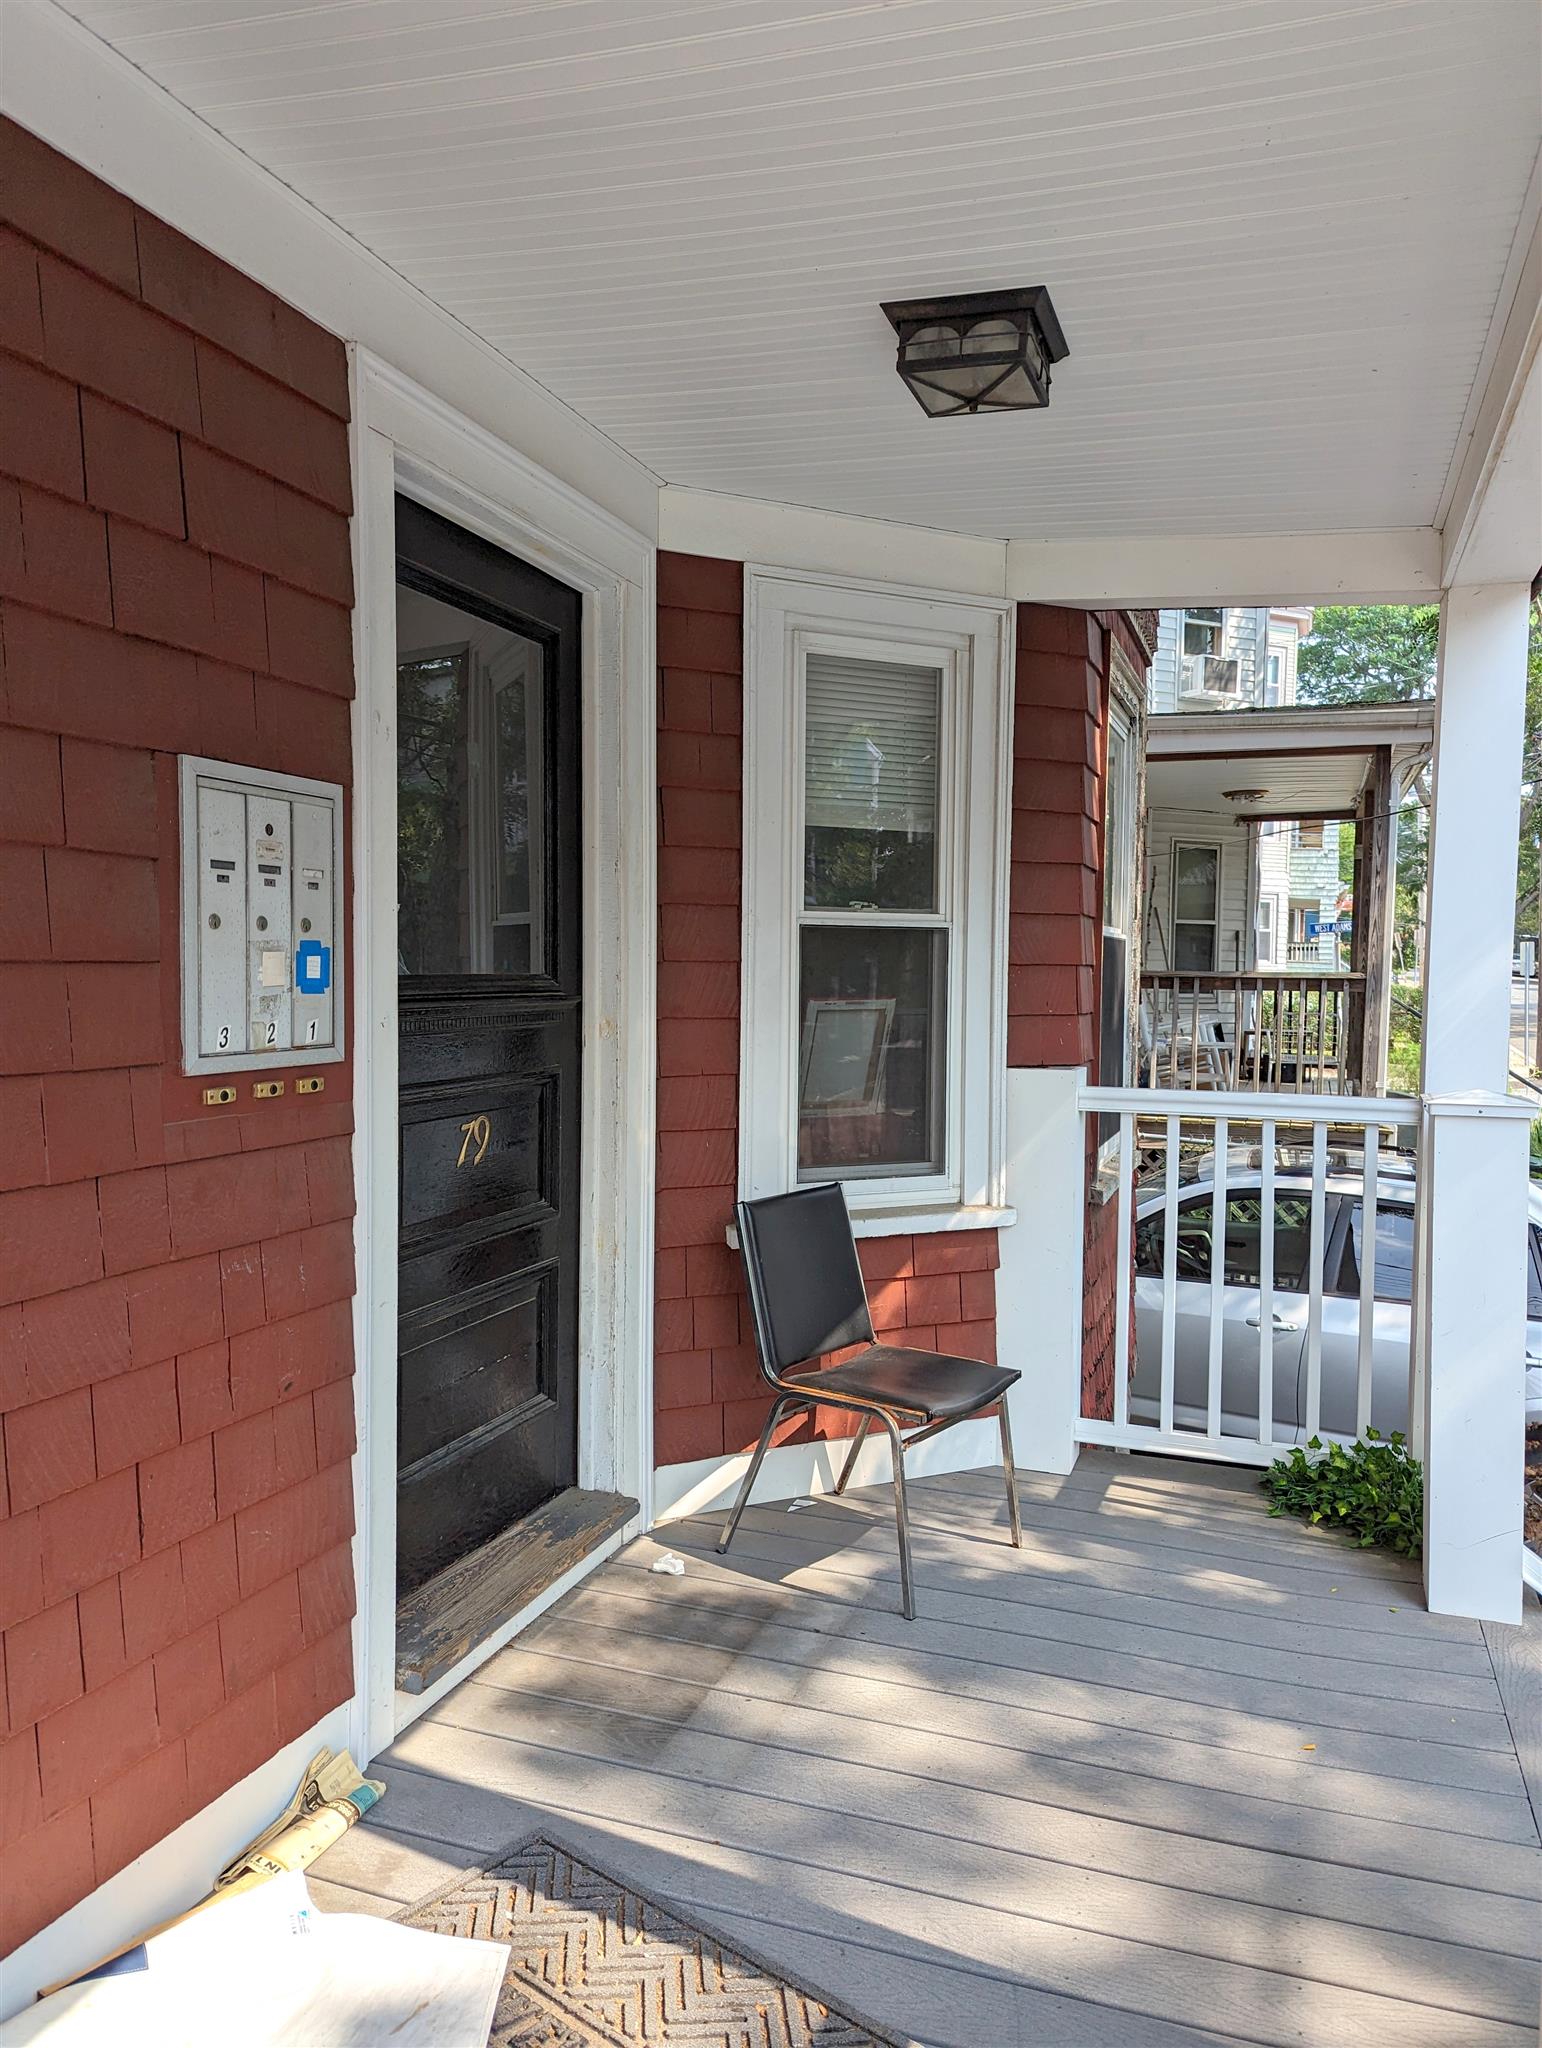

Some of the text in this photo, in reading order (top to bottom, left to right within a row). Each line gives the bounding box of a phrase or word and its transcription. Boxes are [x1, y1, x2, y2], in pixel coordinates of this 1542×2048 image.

[1314, 922, 1352, 933] WEST ADAMS
[219, 1026, 229, 1049] 3
[267, 1022, 276, 1044] 2
[310, 1021, 316, 1041] 1
[456, 1115, 491, 1168] 79
